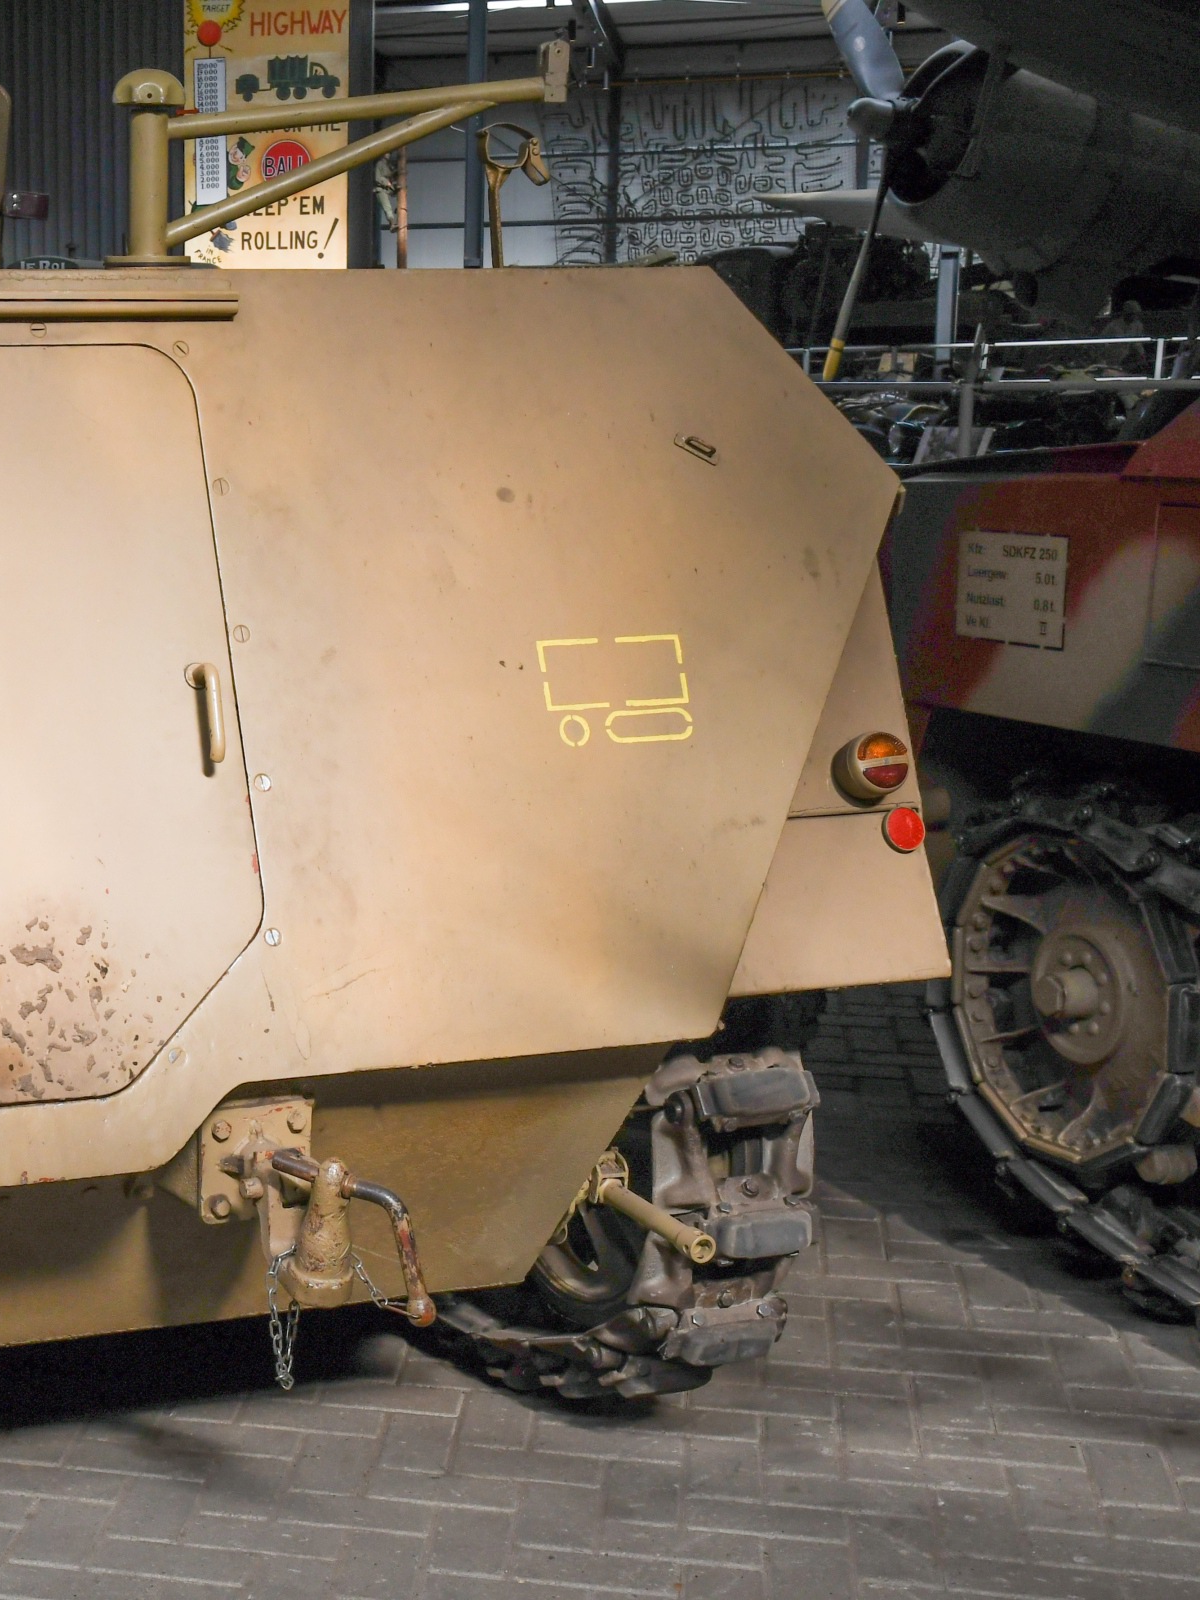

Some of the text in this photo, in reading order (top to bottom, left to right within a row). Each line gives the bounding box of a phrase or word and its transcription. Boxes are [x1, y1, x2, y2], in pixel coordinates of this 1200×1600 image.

[201, 4, 230, 13] TARGET
[250, 9, 347, 36] HIGHWAY
[1002, 545, 1037, 560] SDKFZ
[1039, 548, 1058, 561] 250
